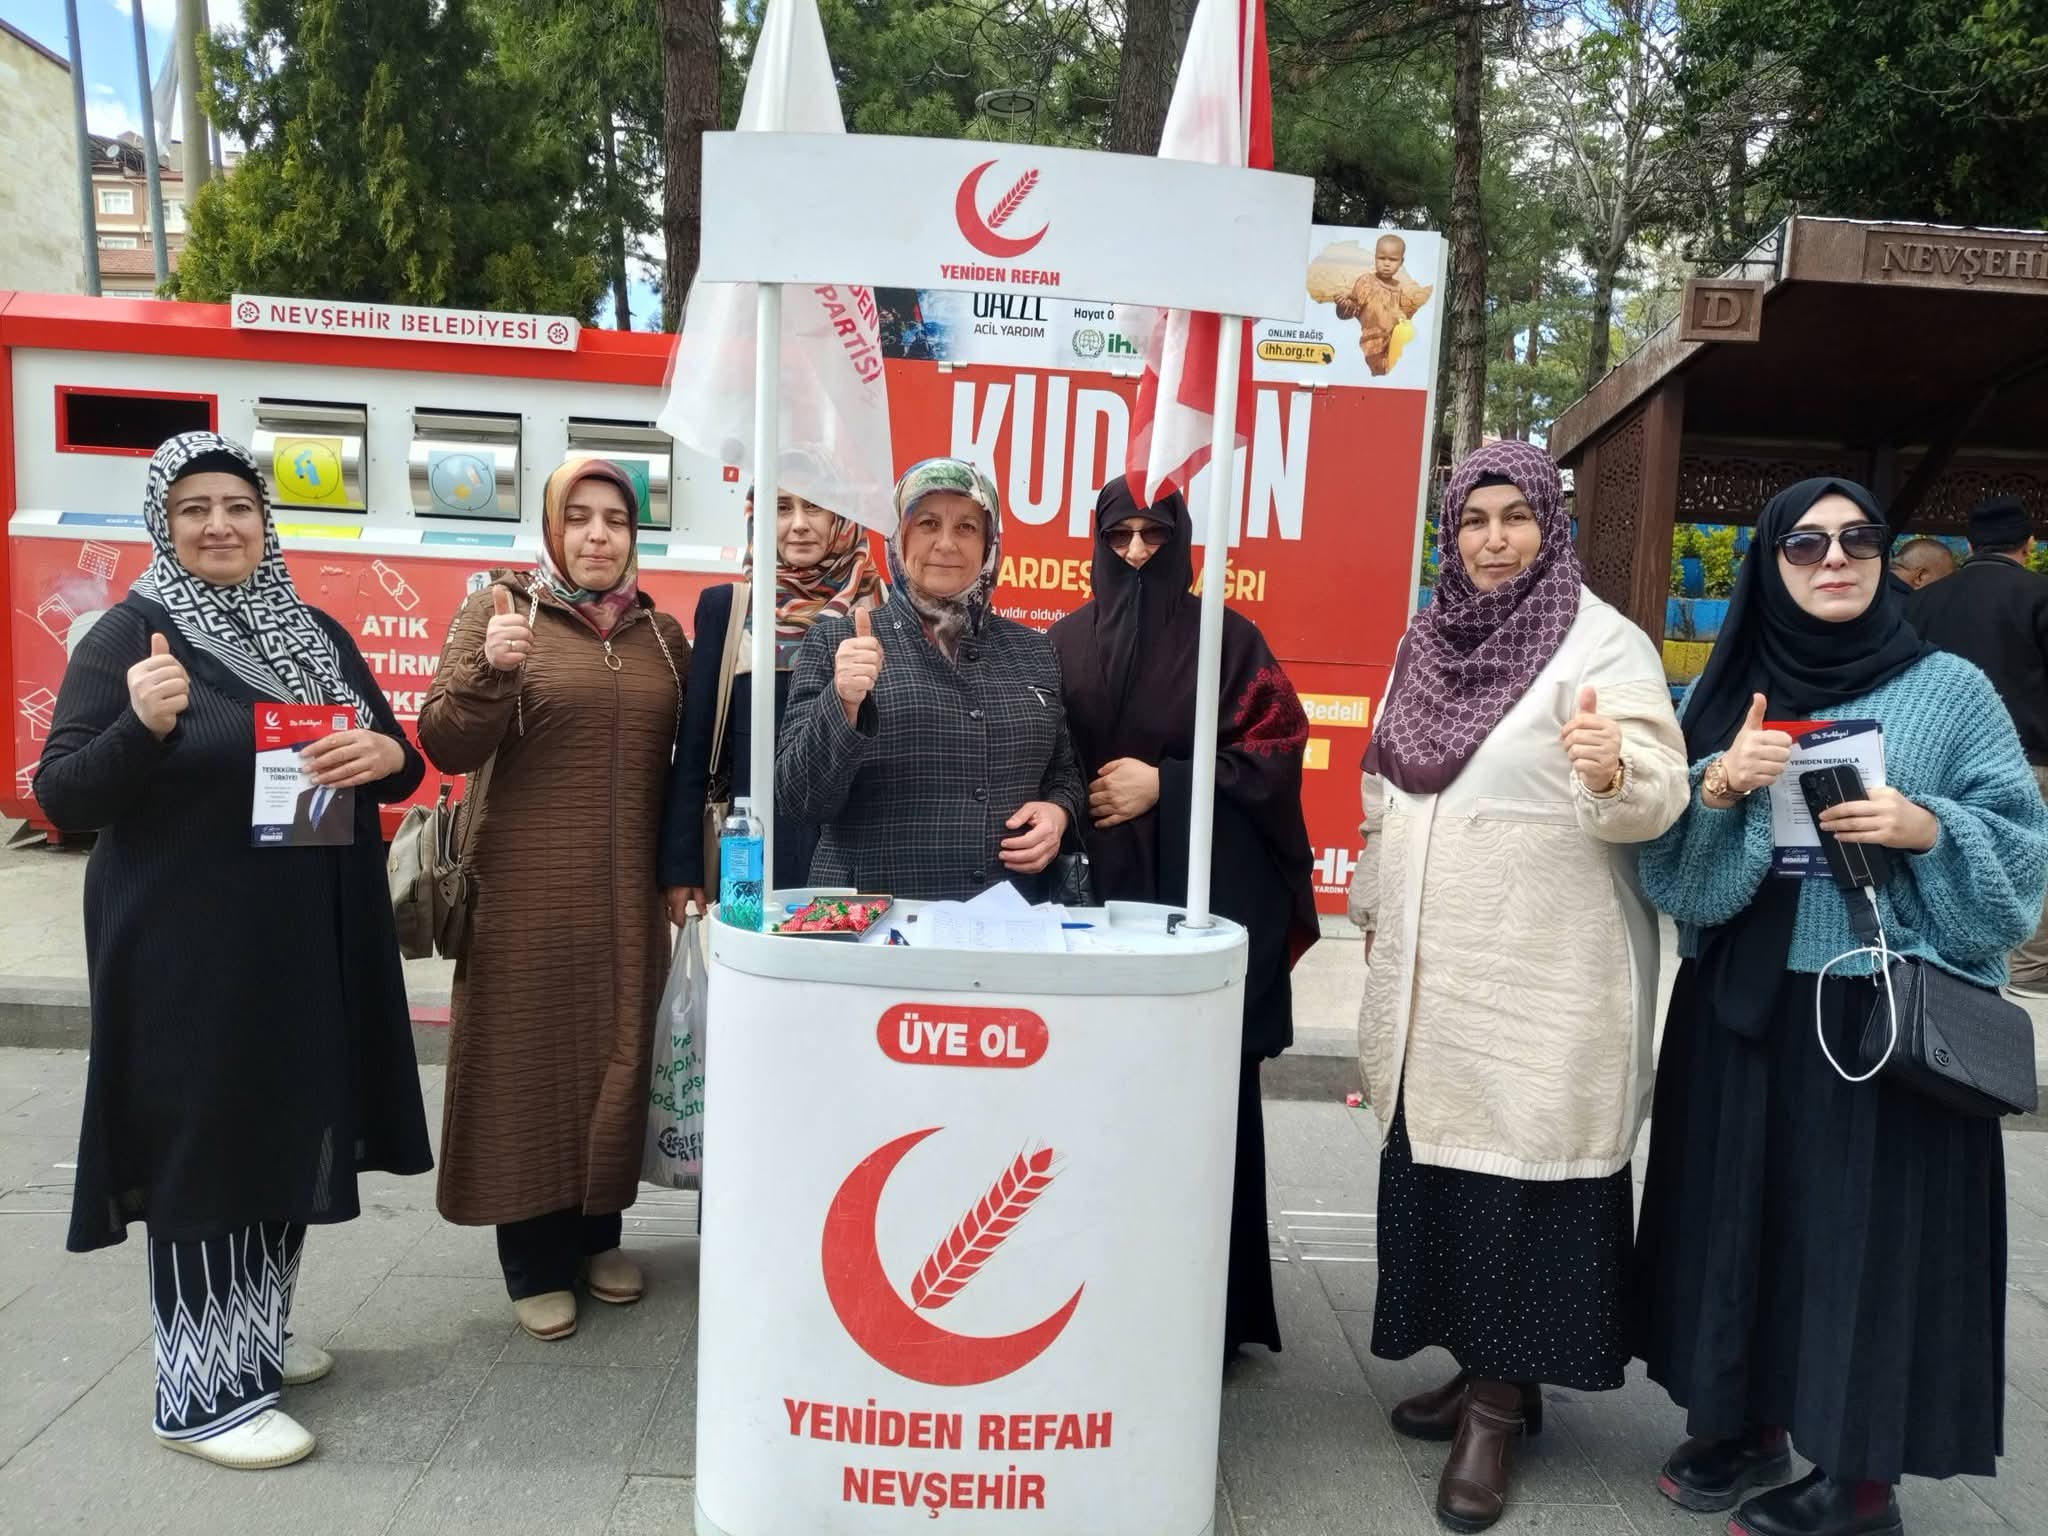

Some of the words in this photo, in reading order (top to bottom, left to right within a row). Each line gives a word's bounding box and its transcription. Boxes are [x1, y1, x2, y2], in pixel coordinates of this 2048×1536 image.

[940, 262, 1006, 282] YENİDEN
[1011, 269, 1060, 286] REFAH
[1074, 308, 1104, 321] Hayat
[1701, 292, 1742, 327] D
[271, 305, 390, 329] NEVŞEHİR
[401, 314, 537, 340] BELEDİYESİ
[974, 322, 998, 336] ACİL
[1000, 326, 1045, 338] YARDIM
[1268, 329, 1297, 339] ONLINE
[1299, 330, 1324, 341] BAĞIŞ
[1265, 343, 1315, 359] ihh.org.tr
[361, 615, 429, 638] ATIK
[899, 1013, 968, 1056] ÜYE
[980, 1024, 1025, 1058] OL
[784, 1398, 962, 1449] YENİDEN
[979, 1412, 1113, 1450] REFAH
[843, 1465, 1046, 1519] NEVŞEHİR
